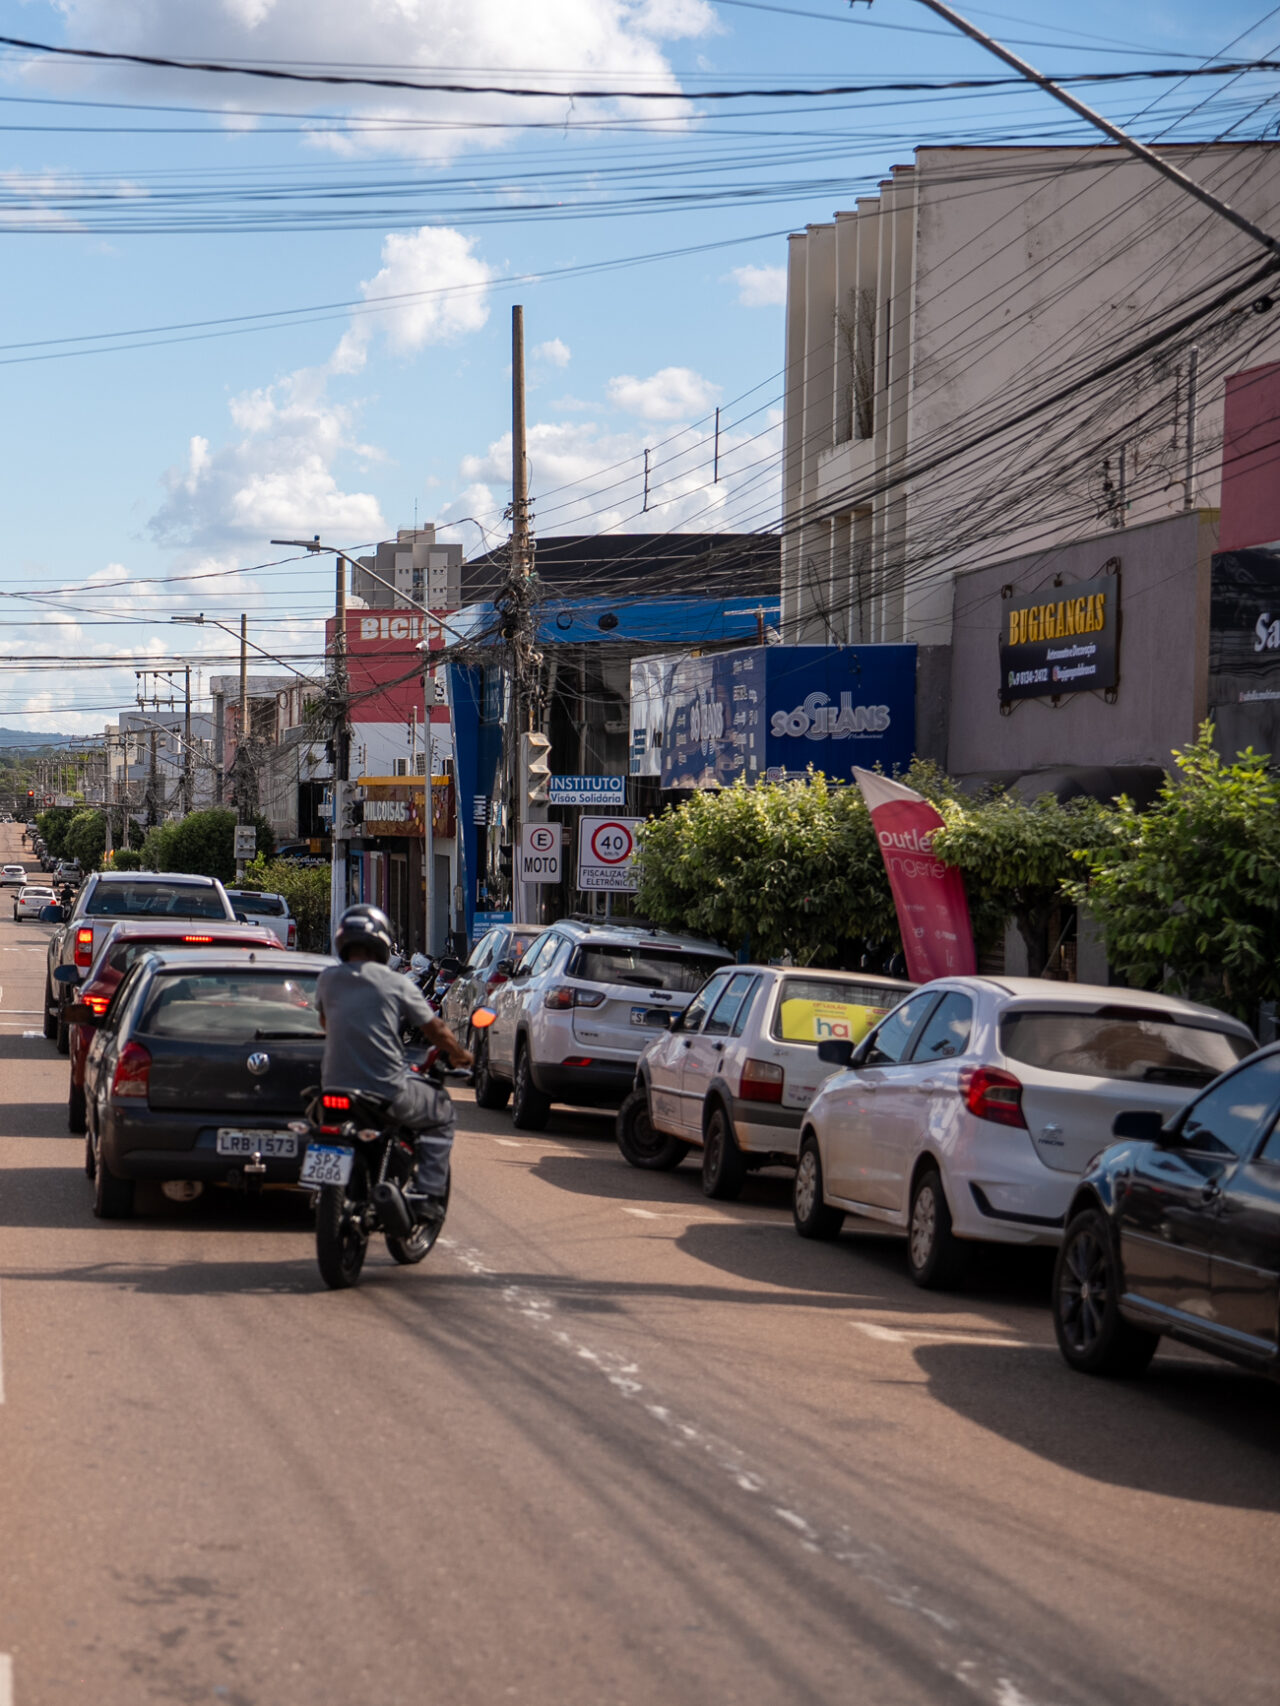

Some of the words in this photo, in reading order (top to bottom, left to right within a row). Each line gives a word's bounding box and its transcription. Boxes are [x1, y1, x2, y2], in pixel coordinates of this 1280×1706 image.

[1009, 593, 1106, 647] BUGIGANGAS
[771, 706, 809, 737] SÓ
[811, 704, 891, 734] JEANS
[550, 777, 621, 790] INSTITUTO
[551, 792, 577, 803] Visão
[580, 792, 621, 803] Solidária
[538, 834, 548, 846] E
[601, 836, 623, 850] 40
[880, 829, 934, 852] outle
[525, 857, 558, 873] MOTO
[816, 1018, 849, 1038] ha
[314, 1153, 342, 1168] SPZ
